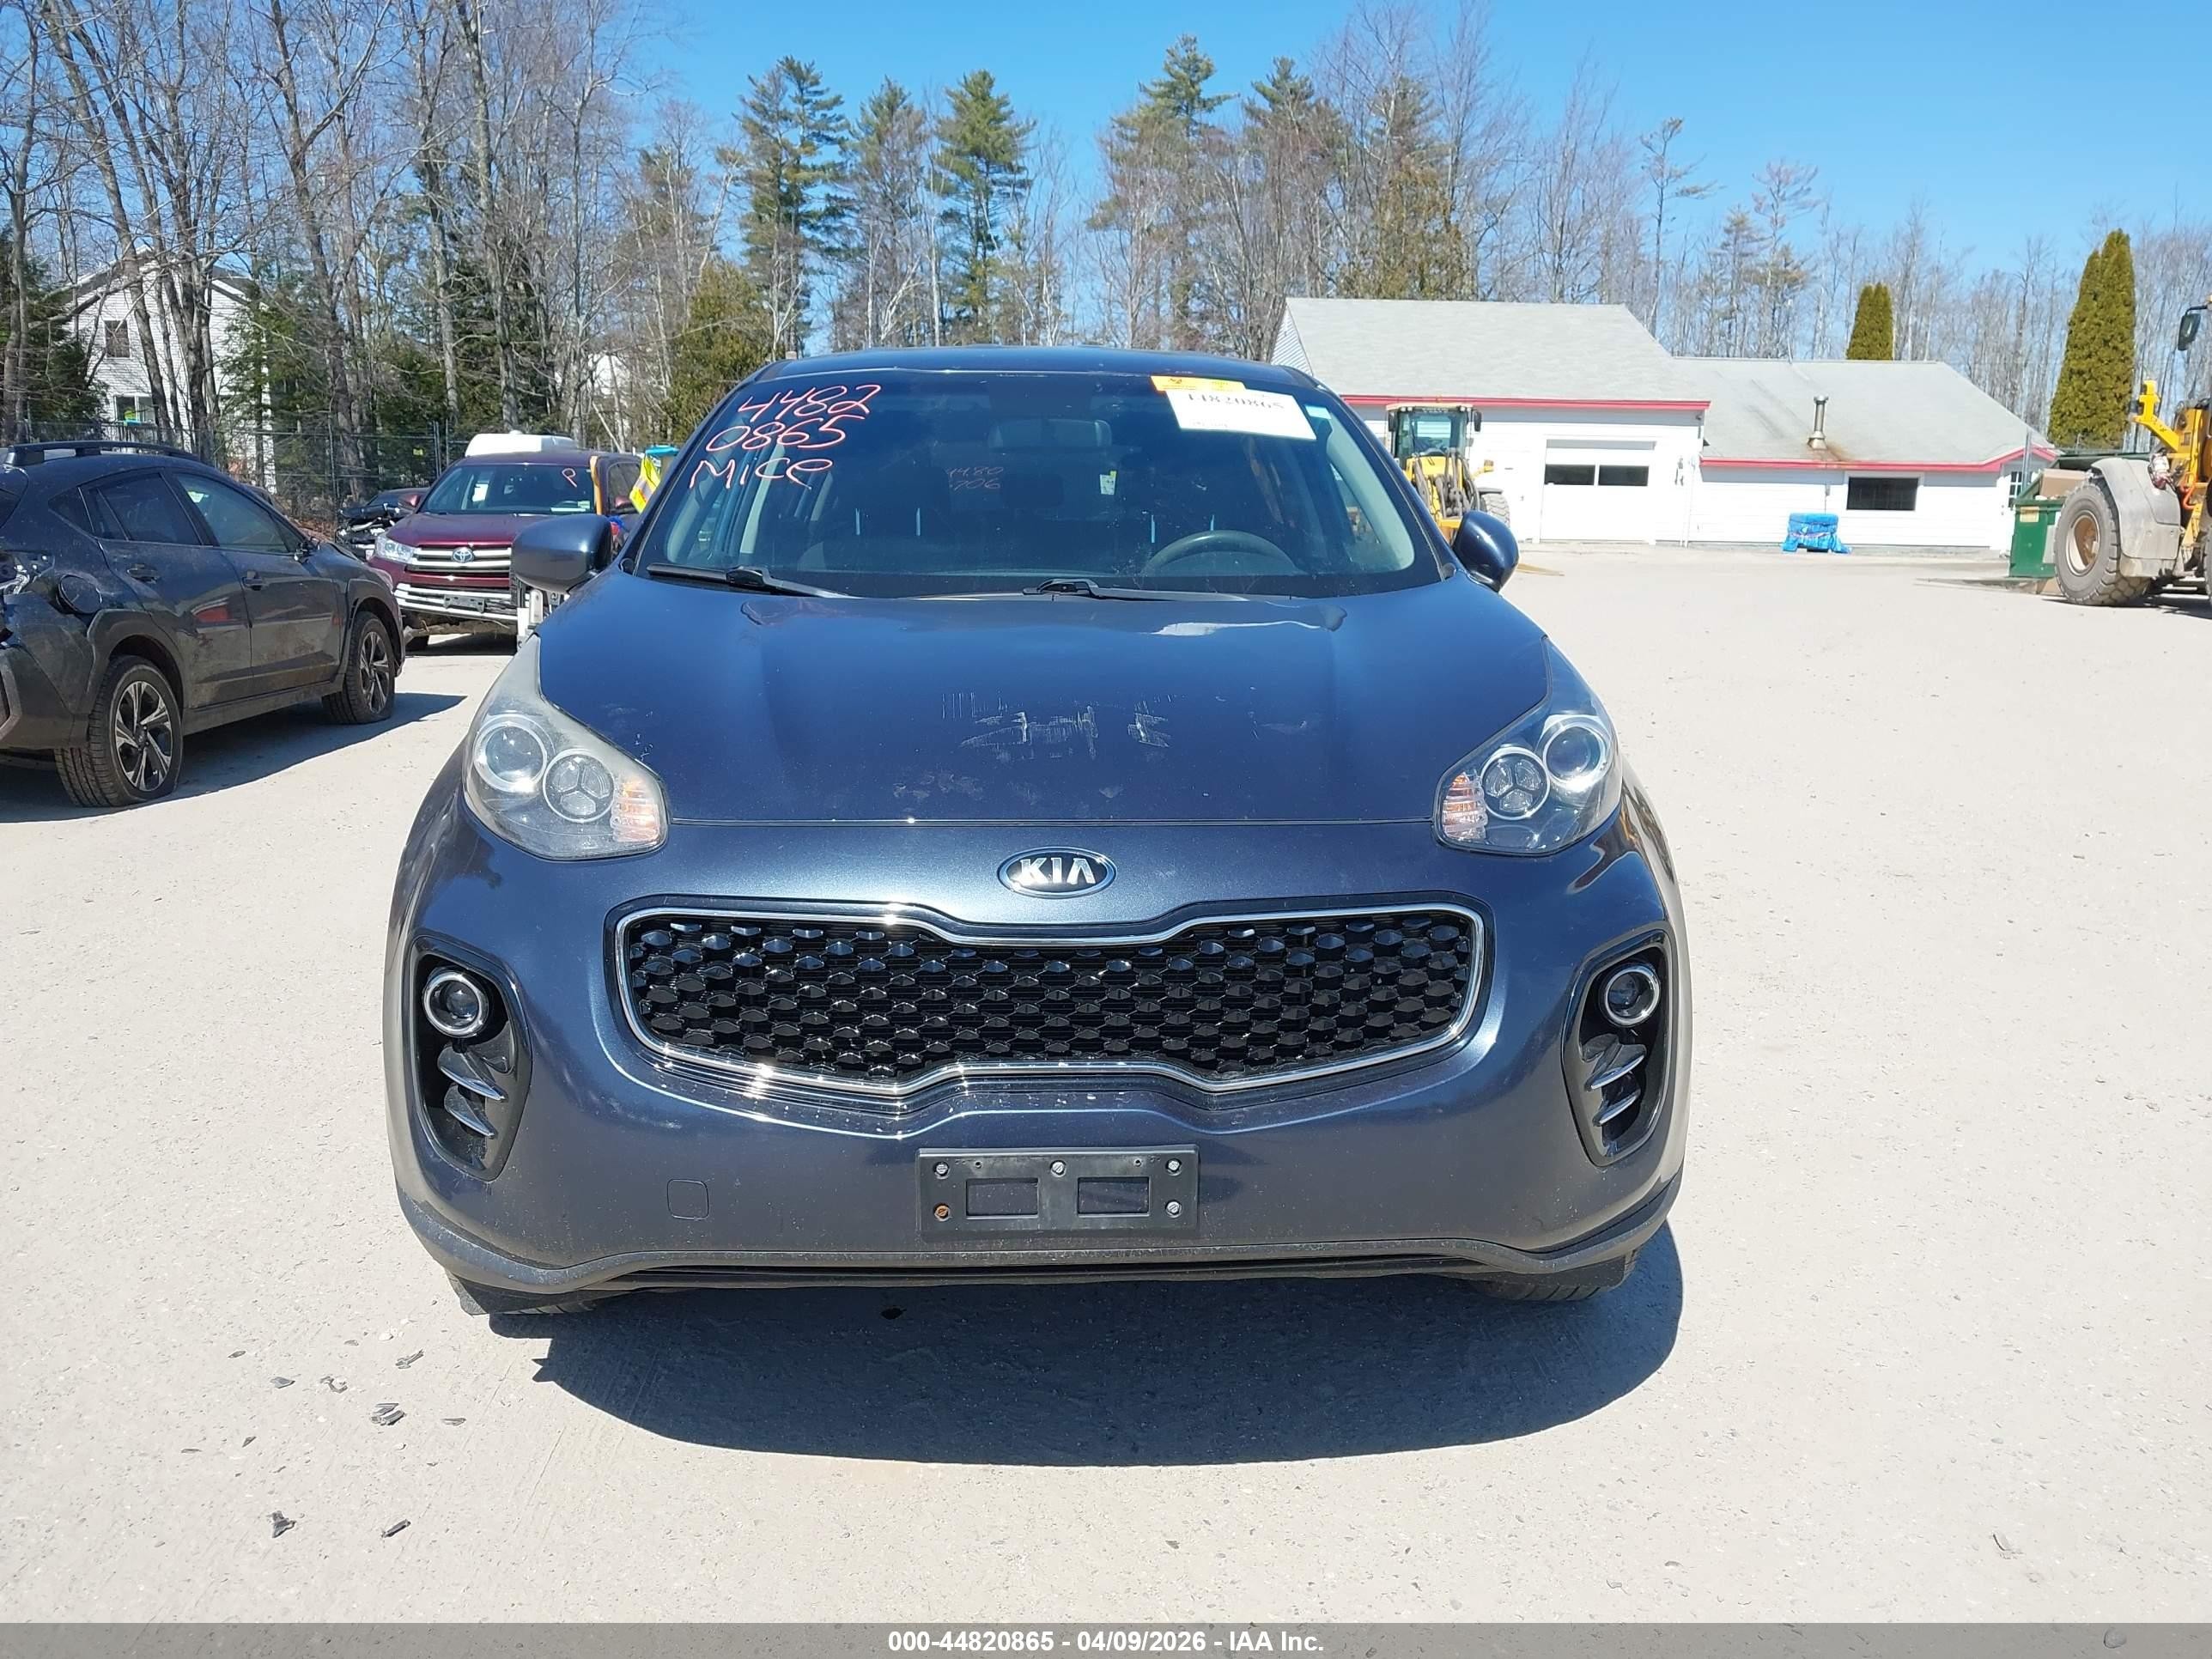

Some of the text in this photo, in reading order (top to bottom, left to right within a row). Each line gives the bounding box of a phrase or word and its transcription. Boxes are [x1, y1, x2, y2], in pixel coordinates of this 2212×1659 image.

[738, 384, 881, 422] 4482
[705, 414, 866, 452] 0865
[1020, 857, 1097, 884] KIA
